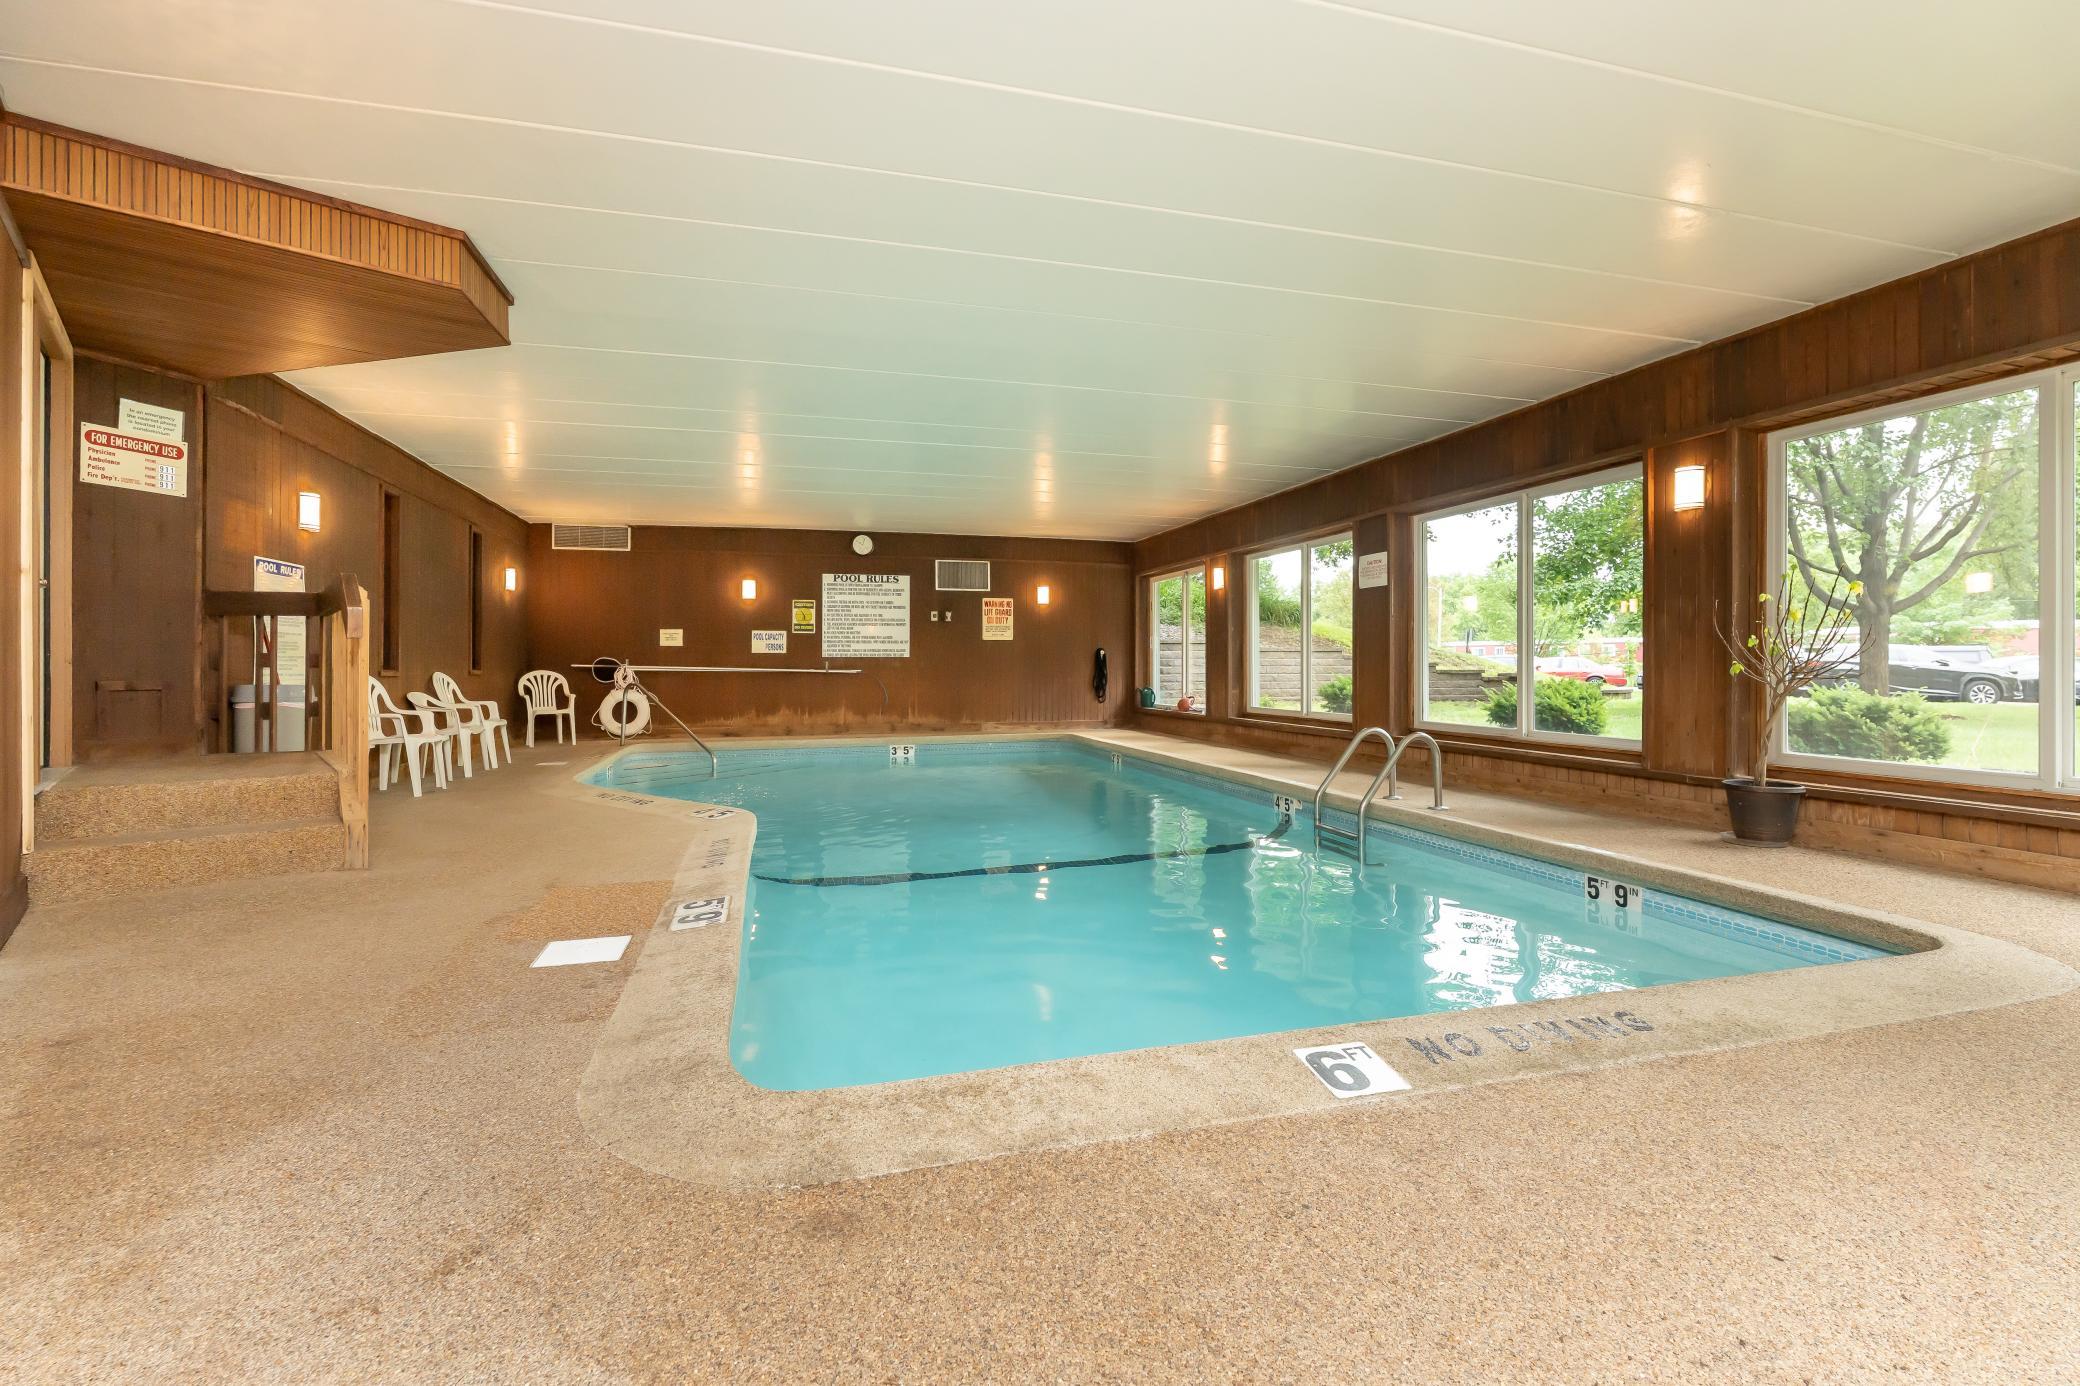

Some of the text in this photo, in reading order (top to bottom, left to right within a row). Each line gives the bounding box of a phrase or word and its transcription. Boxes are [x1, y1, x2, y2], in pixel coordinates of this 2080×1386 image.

[88, 447, 116, 456] Physician
[91, 432, 178, 458] FOR EMERGENCY USE
[88, 456, 120, 465] Ambulance
[259, 562, 302, 579] POOL RULES
[892, 747, 897, 755] 3
[903, 747, 909, 755] 5
[1275, 796, 1290, 812] 4 5
[1587, 877, 1638, 908] 5 FT 9 IN
[1406, 1010, 1654, 1064] NO DIVING
[1306, 1044, 1372, 1091] 6 FT
